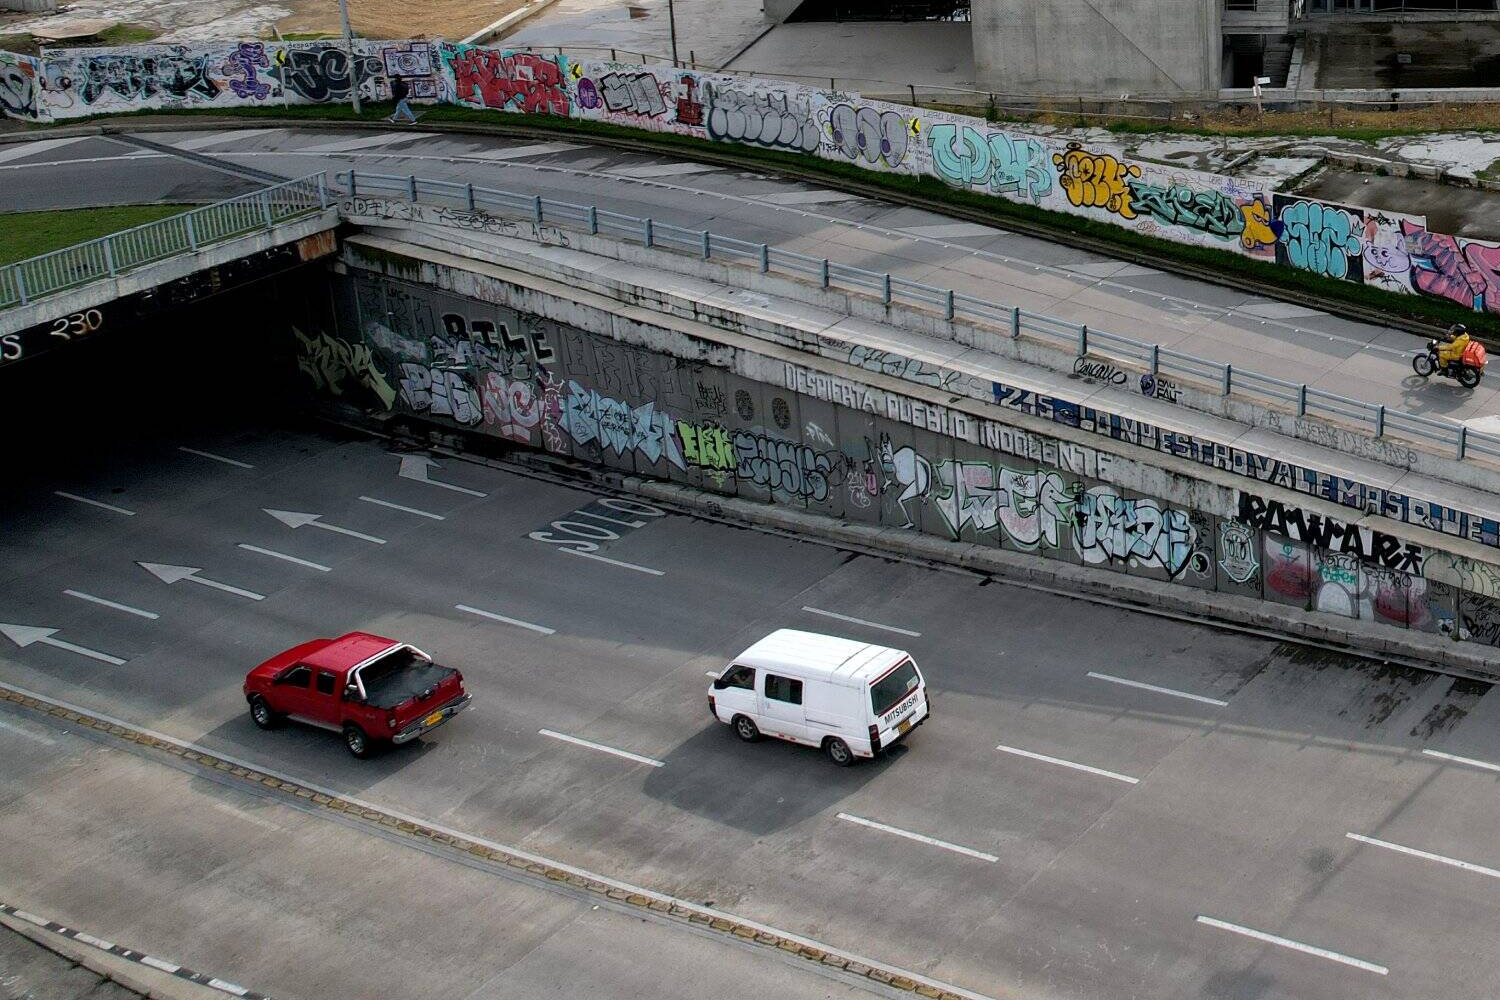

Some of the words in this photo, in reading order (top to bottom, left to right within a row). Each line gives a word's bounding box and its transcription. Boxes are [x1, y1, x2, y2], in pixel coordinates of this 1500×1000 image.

[529, 498, 666, 552] SOLO
[1253, 453, 1331, 500] VALE
[1337, 478, 1403, 521] MAS
[1408, 498, 1484, 543] QUE
[884, 693, 919, 725] MITSUBISHI
